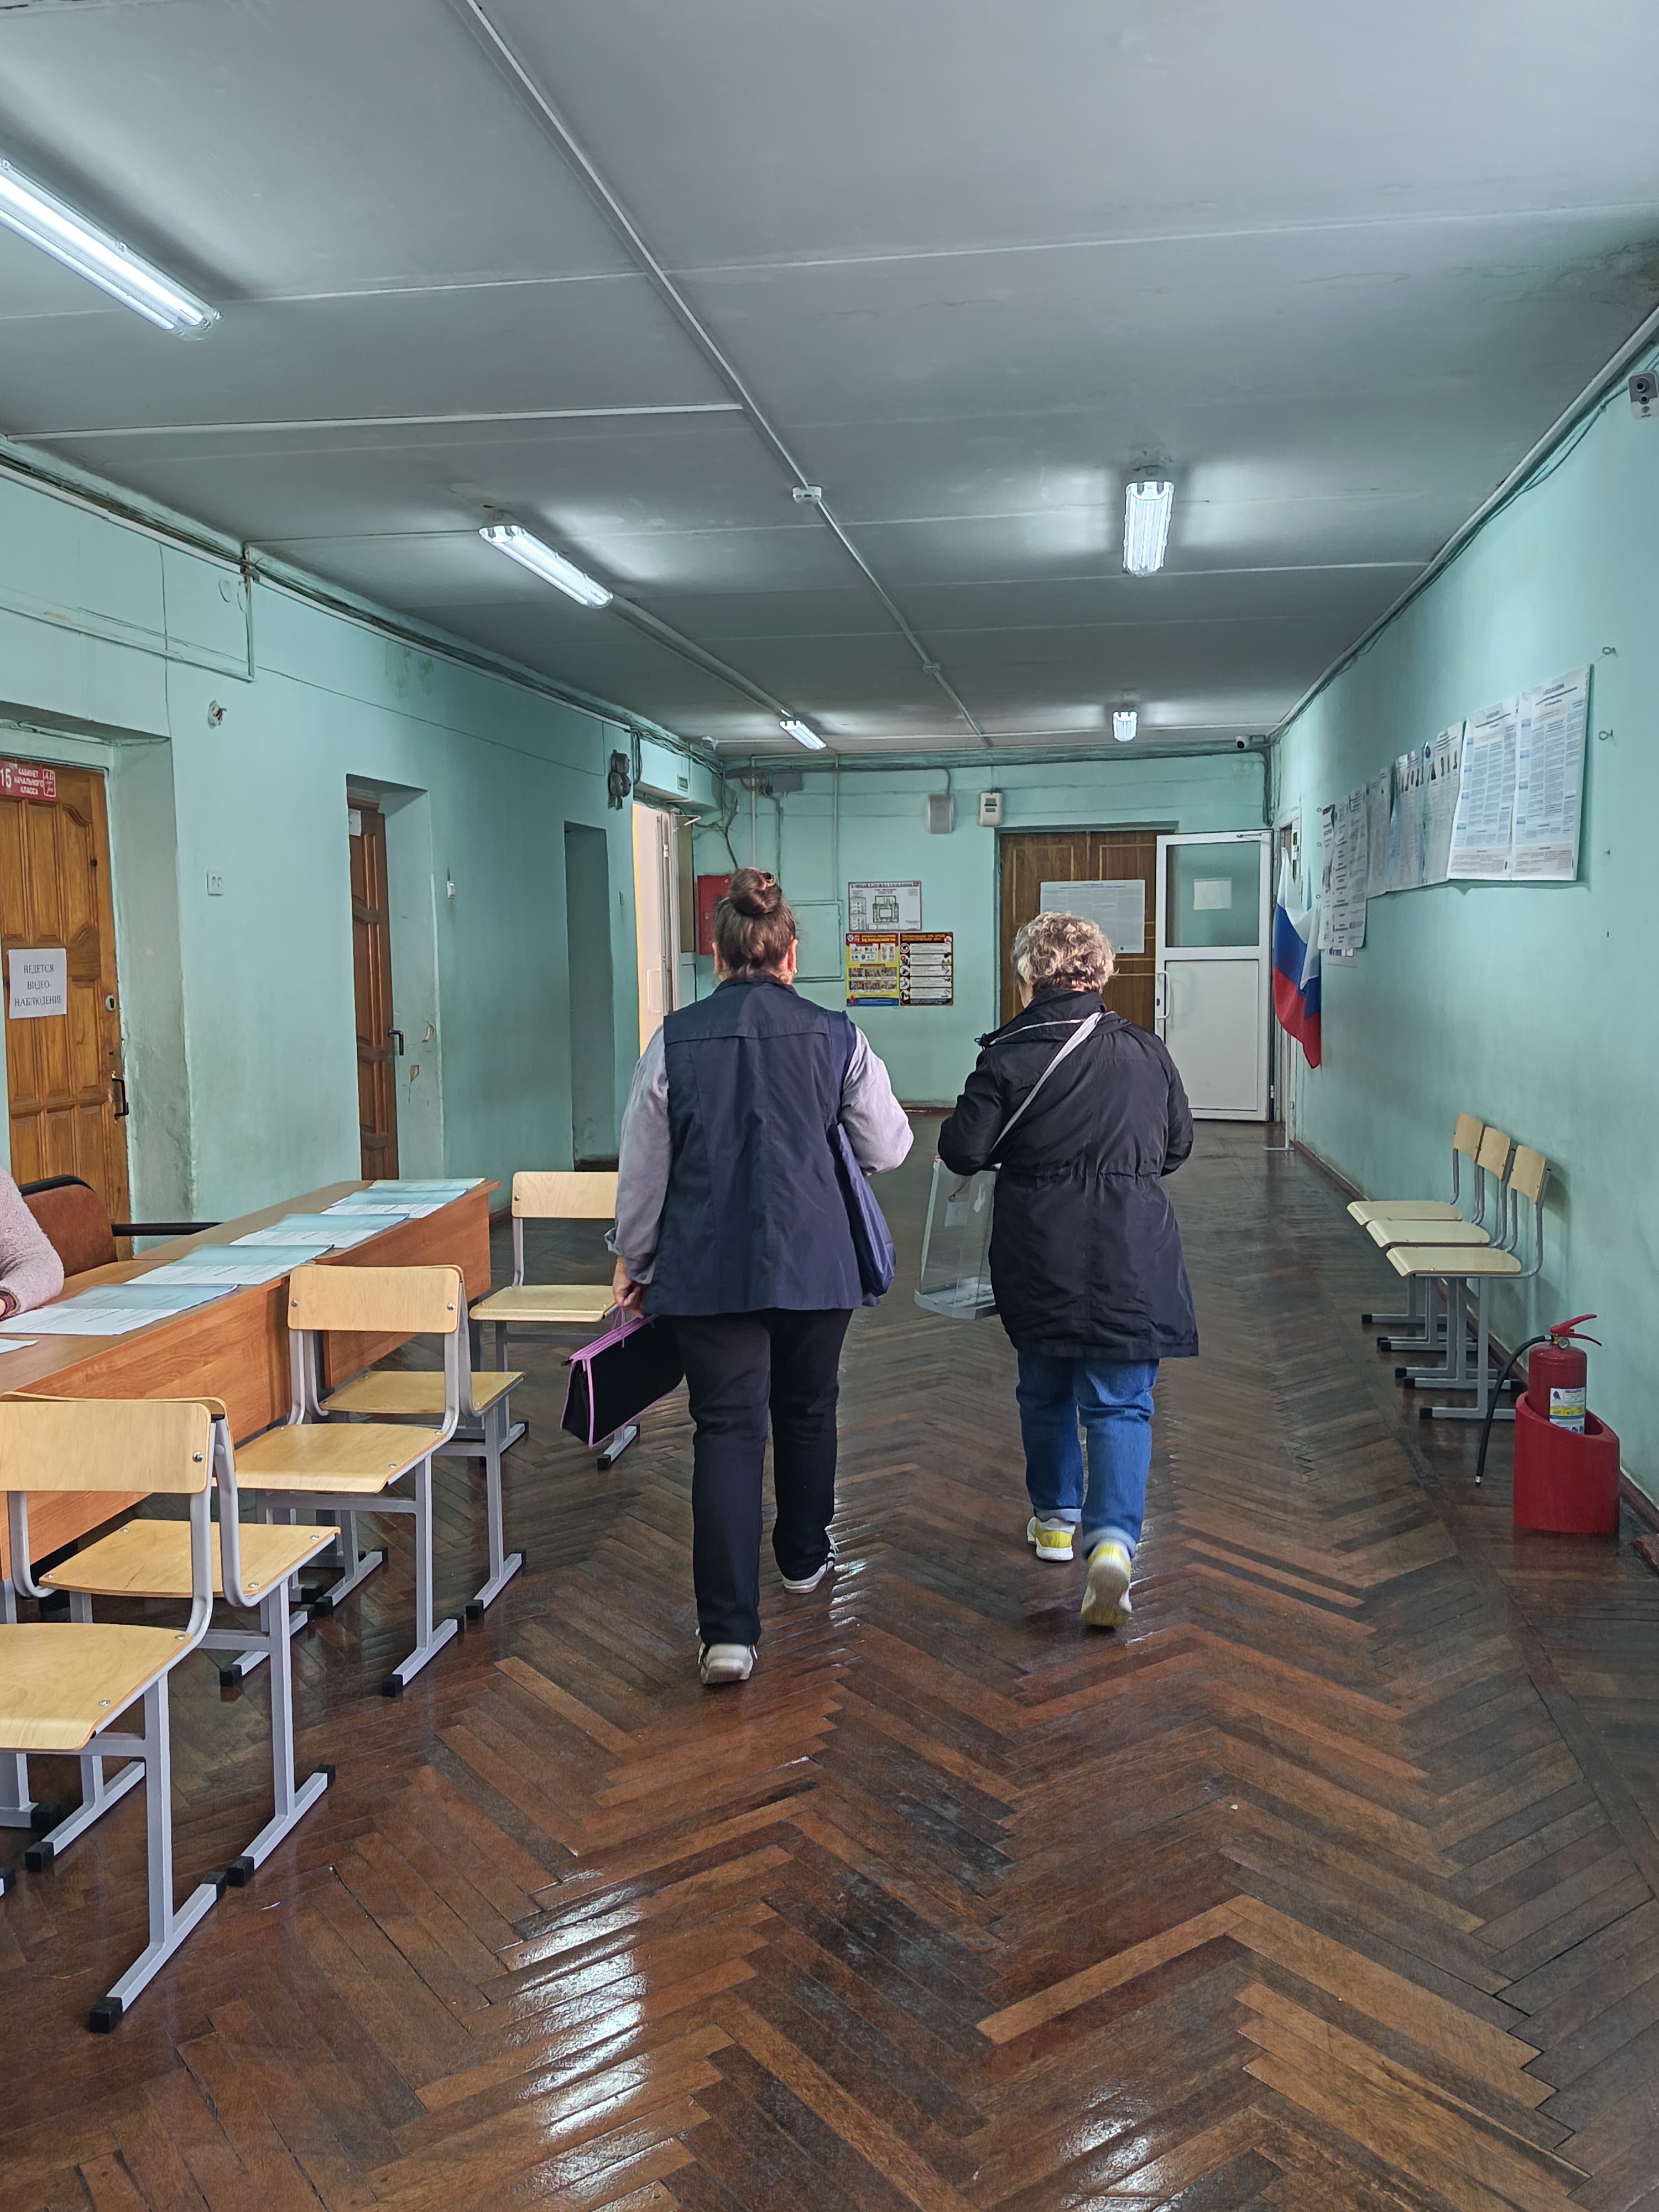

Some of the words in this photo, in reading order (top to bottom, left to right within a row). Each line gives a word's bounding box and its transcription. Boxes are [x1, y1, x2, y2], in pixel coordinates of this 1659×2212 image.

[0, 768, 12, 788] 16
[23, 964, 54, 974] ВЕДЕТСЯ
[14, 995, 62, 1007] НАБЛЮДЕНИЕ
